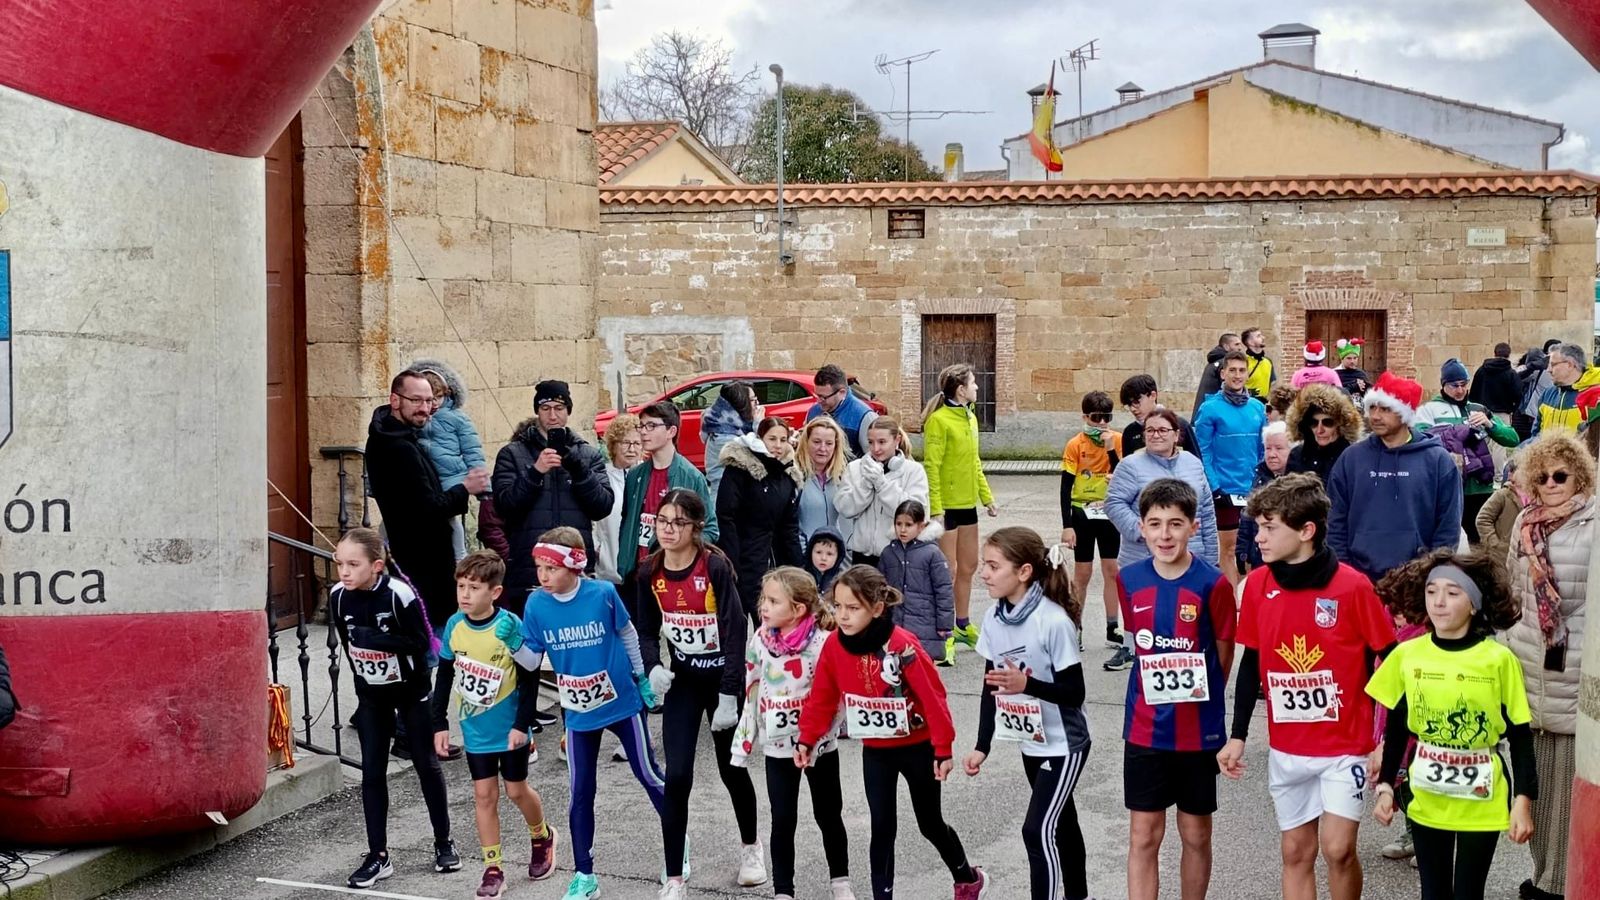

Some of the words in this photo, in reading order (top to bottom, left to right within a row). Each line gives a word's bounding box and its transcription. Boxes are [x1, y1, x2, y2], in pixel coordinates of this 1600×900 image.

[4, 483, 71, 533] ón
[664, 615, 716, 628] bedunia
[543, 629, 556, 644] LA
[558, 621, 606, 642] ARMUÑA
[671, 627, 707, 645] 331
[552, 642, 566, 651] CLUB
[567, 637, 603, 648] DEPORTIVO
[1155, 635, 1194, 652] Spotify
[354, 659, 388, 676] 339
[691, 656, 726, 669] NIKE
[1142, 656, 1204, 670] bedunia
[1152, 669, 1196, 692] 333
[1270, 674, 1333, 688] bedunia
[567, 684, 605, 704] 332
[847, 697, 905, 711] bedunia
[1282, 688, 1328, 710] 330
[858, 709, 898, 729] 338
[1001, 712, 1034, 734] 336
[1419, 745, 1490, 766] bedunia
[1351, 764, 1365, 789] 8
[1426, 762, 1479, 786] 329
